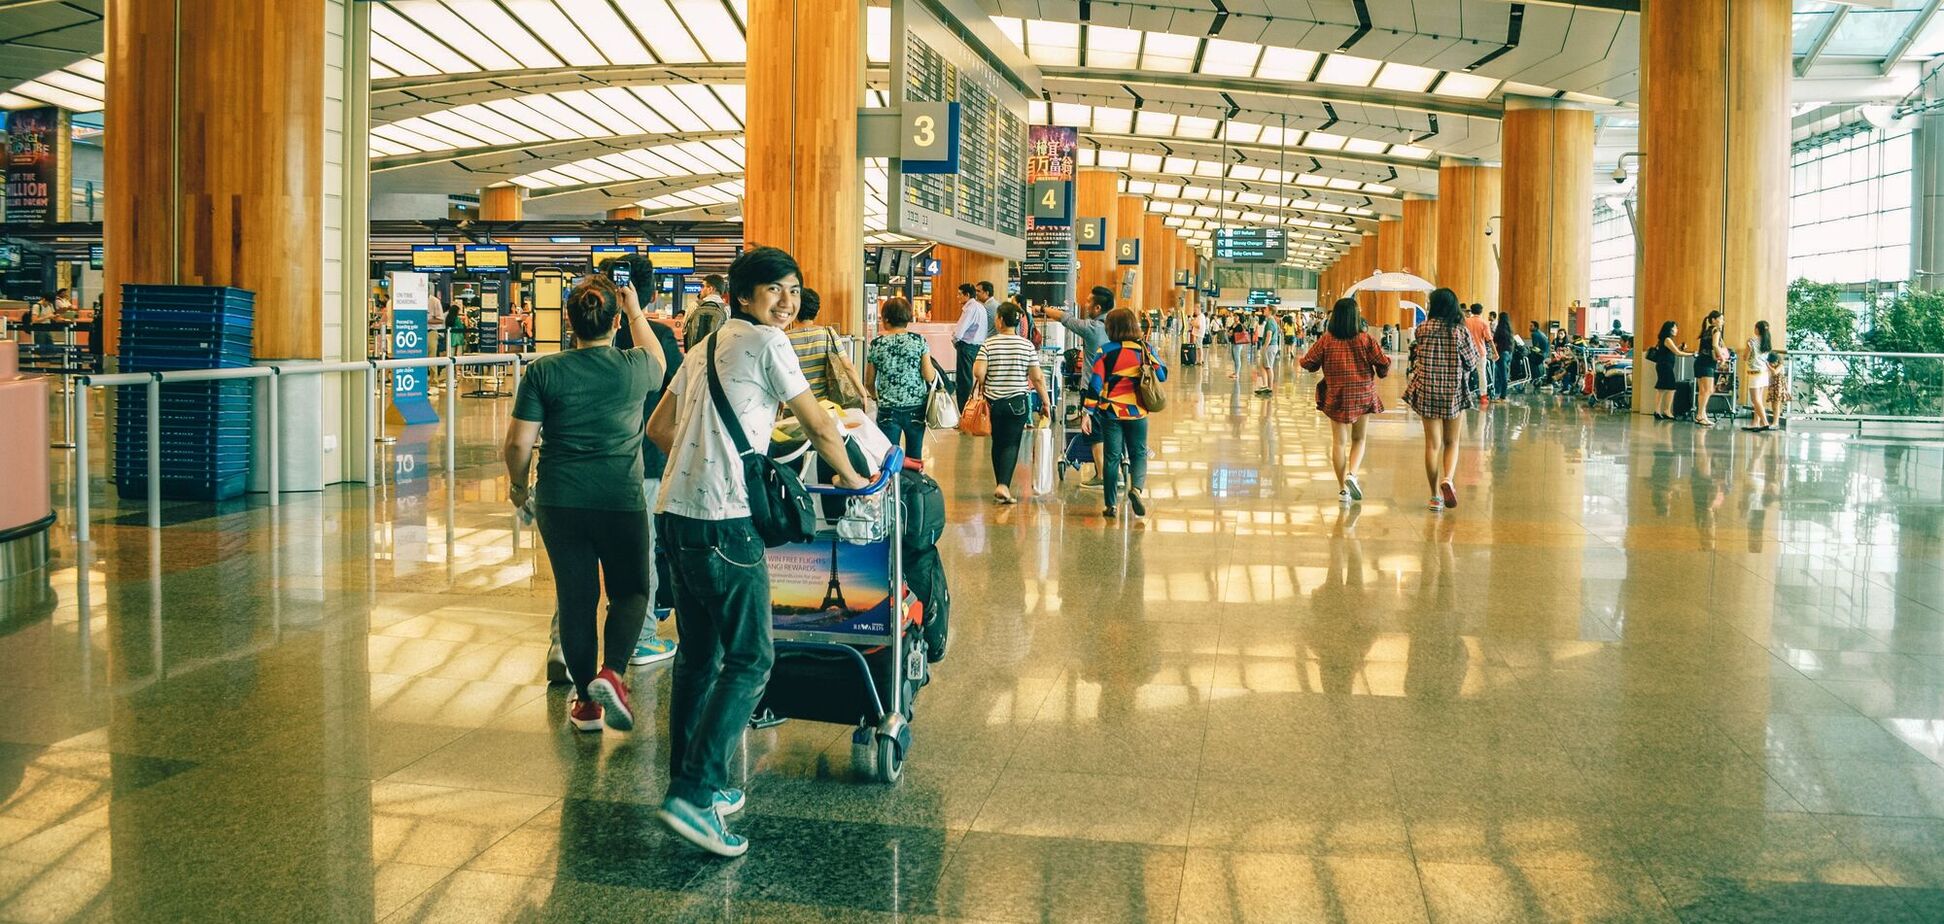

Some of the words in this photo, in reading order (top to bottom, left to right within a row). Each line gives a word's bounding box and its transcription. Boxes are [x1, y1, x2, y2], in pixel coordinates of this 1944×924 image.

[914, 115, 935, 147] 3
[1042, 189, 1056, 209] 4
[1083, 223, 1095, 239] 5
[1122, 243, 1131, 256] 6
[927, 261, 939, 275] 4
[1177, 272, 1184, 280] 7
[1203, 280, 1209, 288] 9
[396, 331, 417, 348] 60
[396, 374, 415, 391] 10
